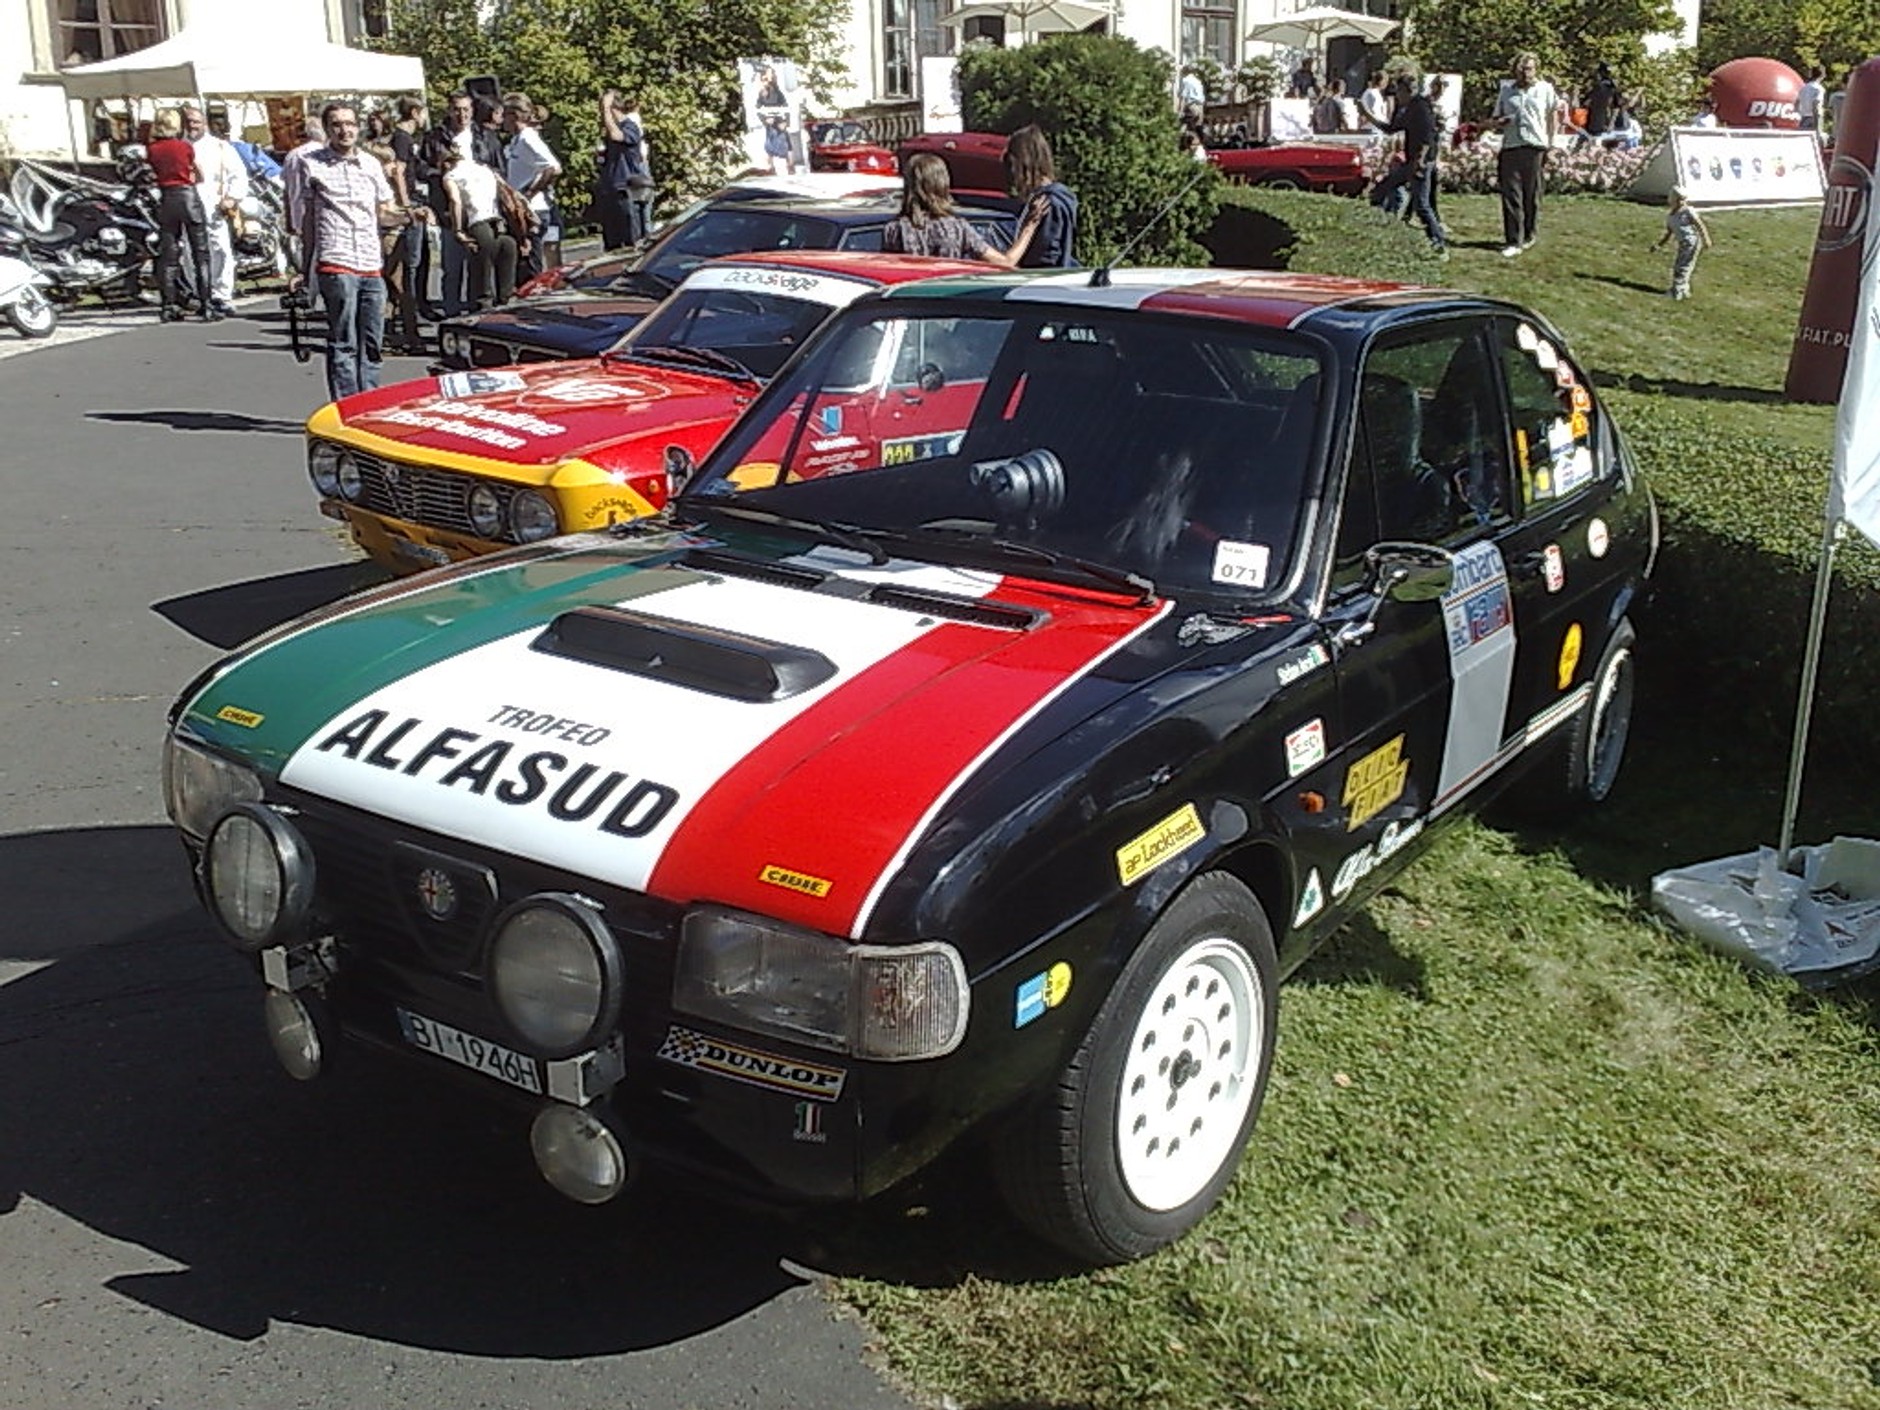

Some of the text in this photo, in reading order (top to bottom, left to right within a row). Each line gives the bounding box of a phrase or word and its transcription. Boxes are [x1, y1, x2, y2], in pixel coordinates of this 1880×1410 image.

[1824, 185, 1859, 227] IAT
[1221, 564, 1257, 581] 071
[487, 705, 612, 746] TROFEO
[316, 708, 681, 838] ALFASUD
[1141, 813, 1198, 863] Lockheed
[410, 1016, 538, 1089] BI 1946H
[702, 1045, 839, 1086] DUNLOP
